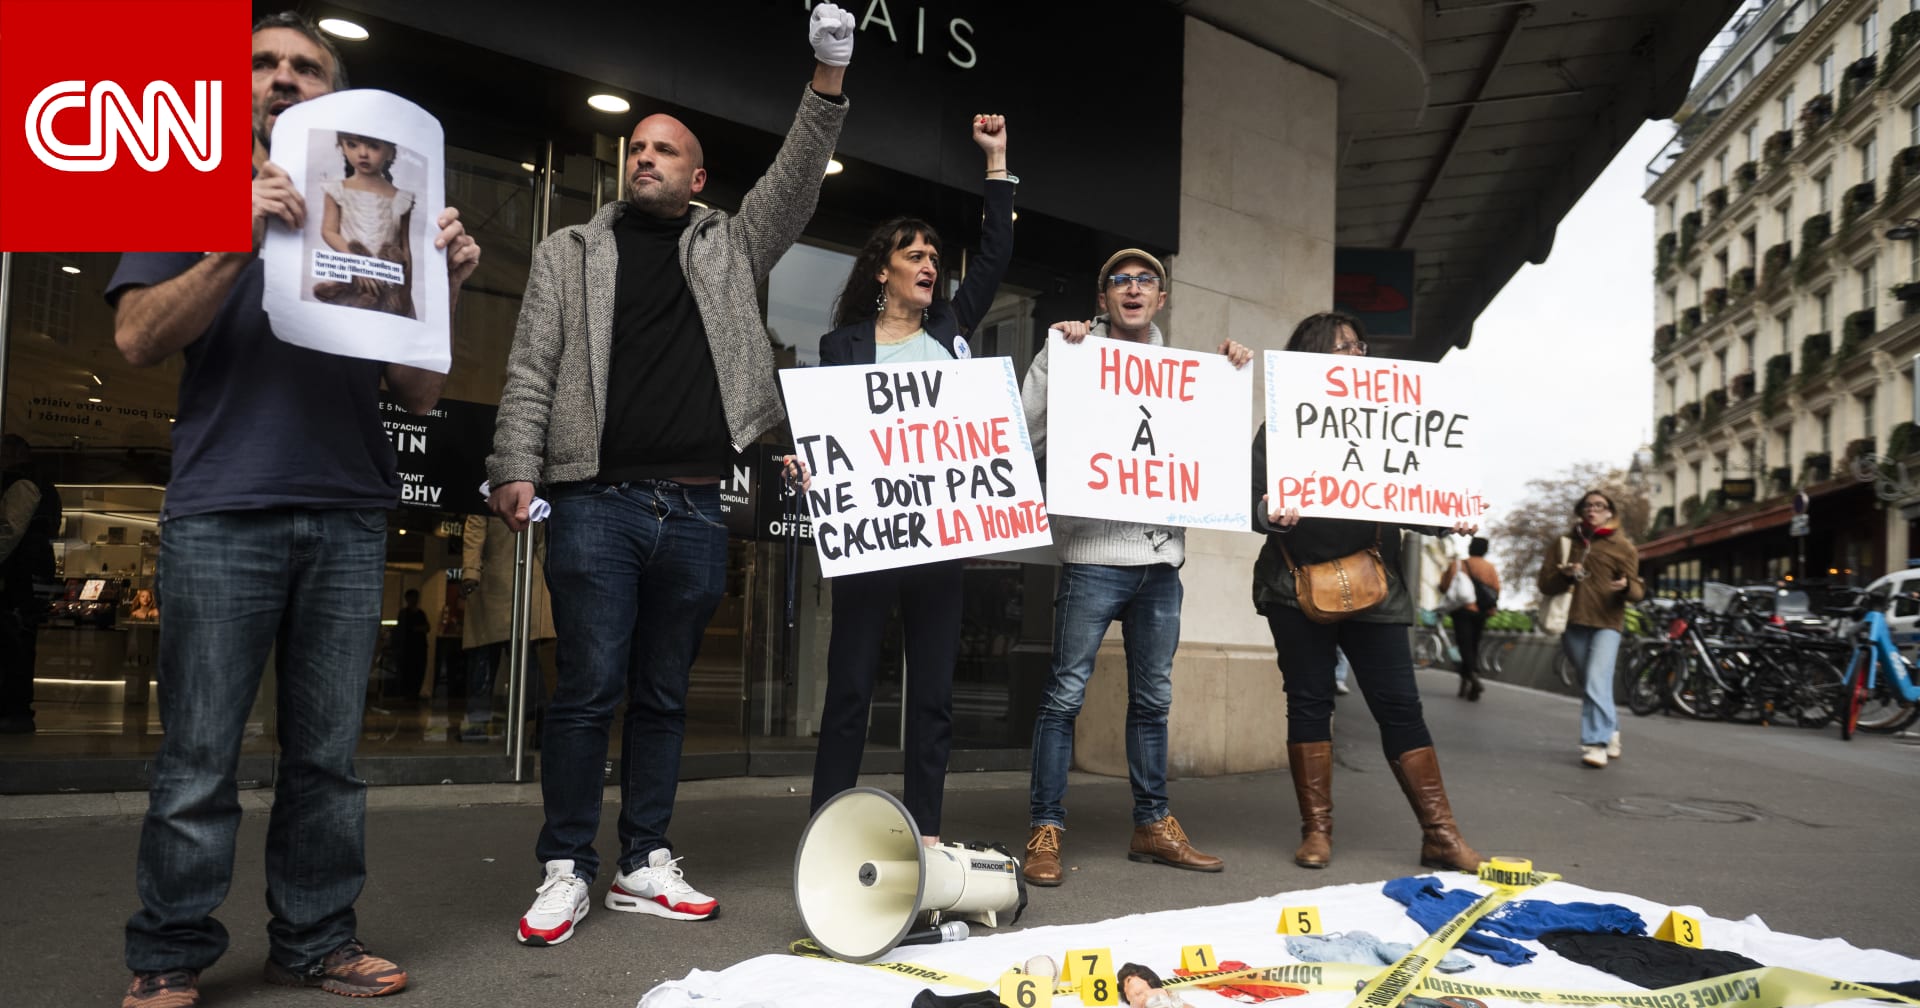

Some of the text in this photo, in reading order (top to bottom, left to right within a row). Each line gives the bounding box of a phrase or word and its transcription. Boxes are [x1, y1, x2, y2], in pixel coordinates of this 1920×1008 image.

[805, 0, 977, 69] AIS
[1100, 347, 1200, 402] HONTE
[865, 370, 942, 414] BHV
[387, 403, 393, 411] 5
[392, 422, 428, 433] D'ACHAT
[1131, 404, 1156, 456] À
[797, 435, 854, 477] TA
[1341, 440, 1421, 475] À LA
[397, 472, 425, 482] TANT
[809, 481, 857, 518] NE
[945, 457, 1017, 503] PAS
[401, 483, 442, 503] BHV
[818, 500, 1049, 560] CACHER LA HONTE
[1298, 911, 1312, 934] 5
[1682, 919, 1694, 943] 3
[1082, 955, 1098, 975] 7
[1195, 948, 1208, 967] 1
[1016, 980, 1036, 1008] 6
[1093, 978, 1109, 1002] 8
